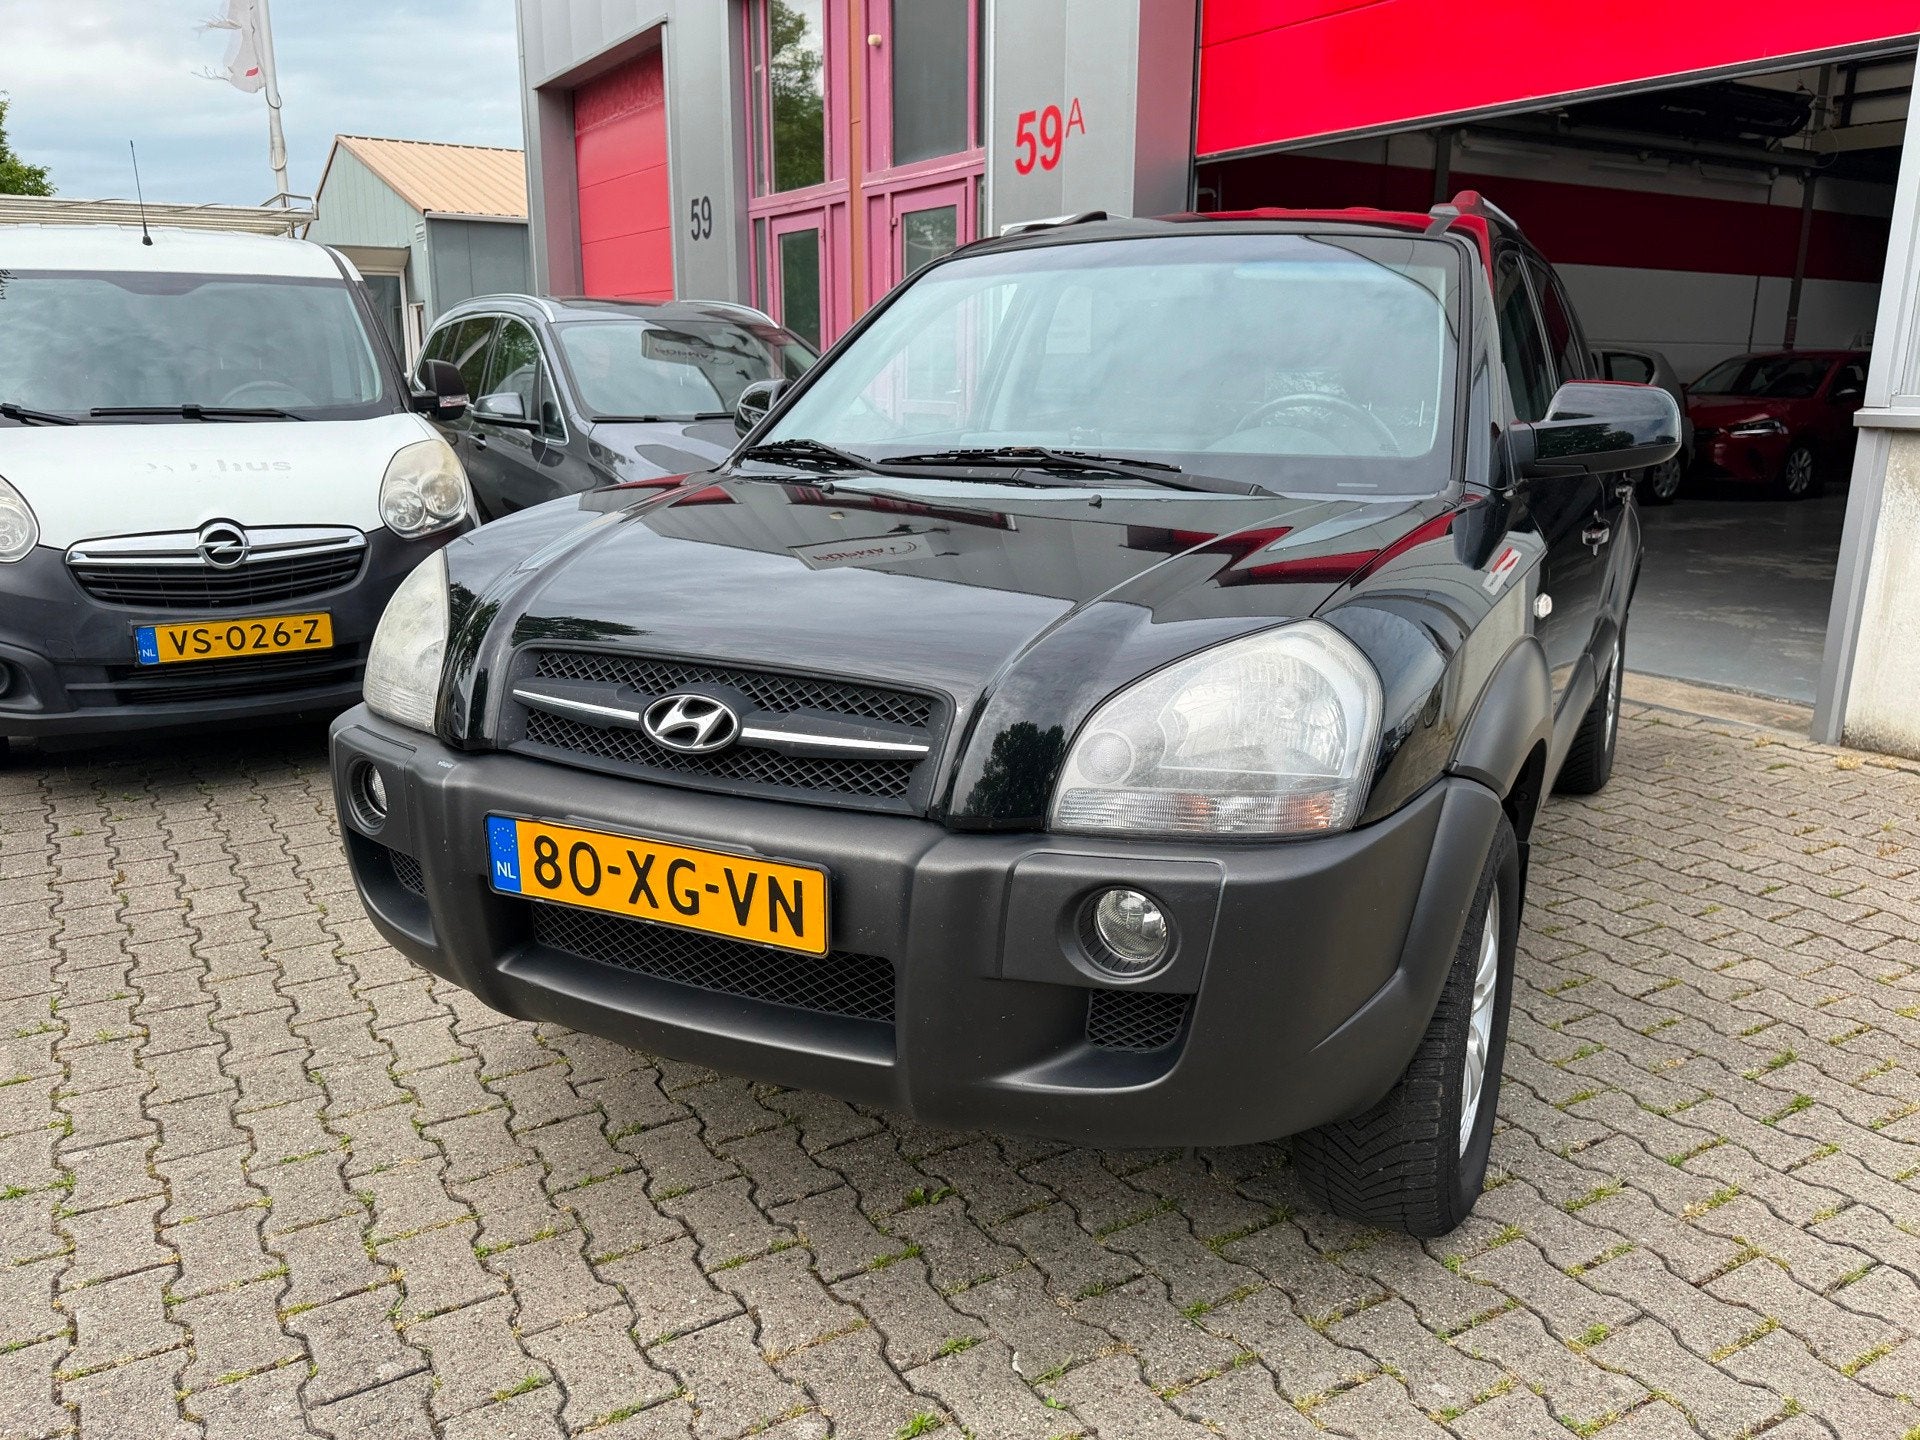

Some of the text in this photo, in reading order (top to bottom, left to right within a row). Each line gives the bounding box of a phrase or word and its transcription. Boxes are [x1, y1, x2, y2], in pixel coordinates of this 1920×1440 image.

[691, 195, 713, 241] 59
[142, 648, 157, 658] NL
[168, 618, 322, 656] VS-026-Z
[496, 859, 517, 881] NL
[533, 834, 805, 938] 80-XG-VN
